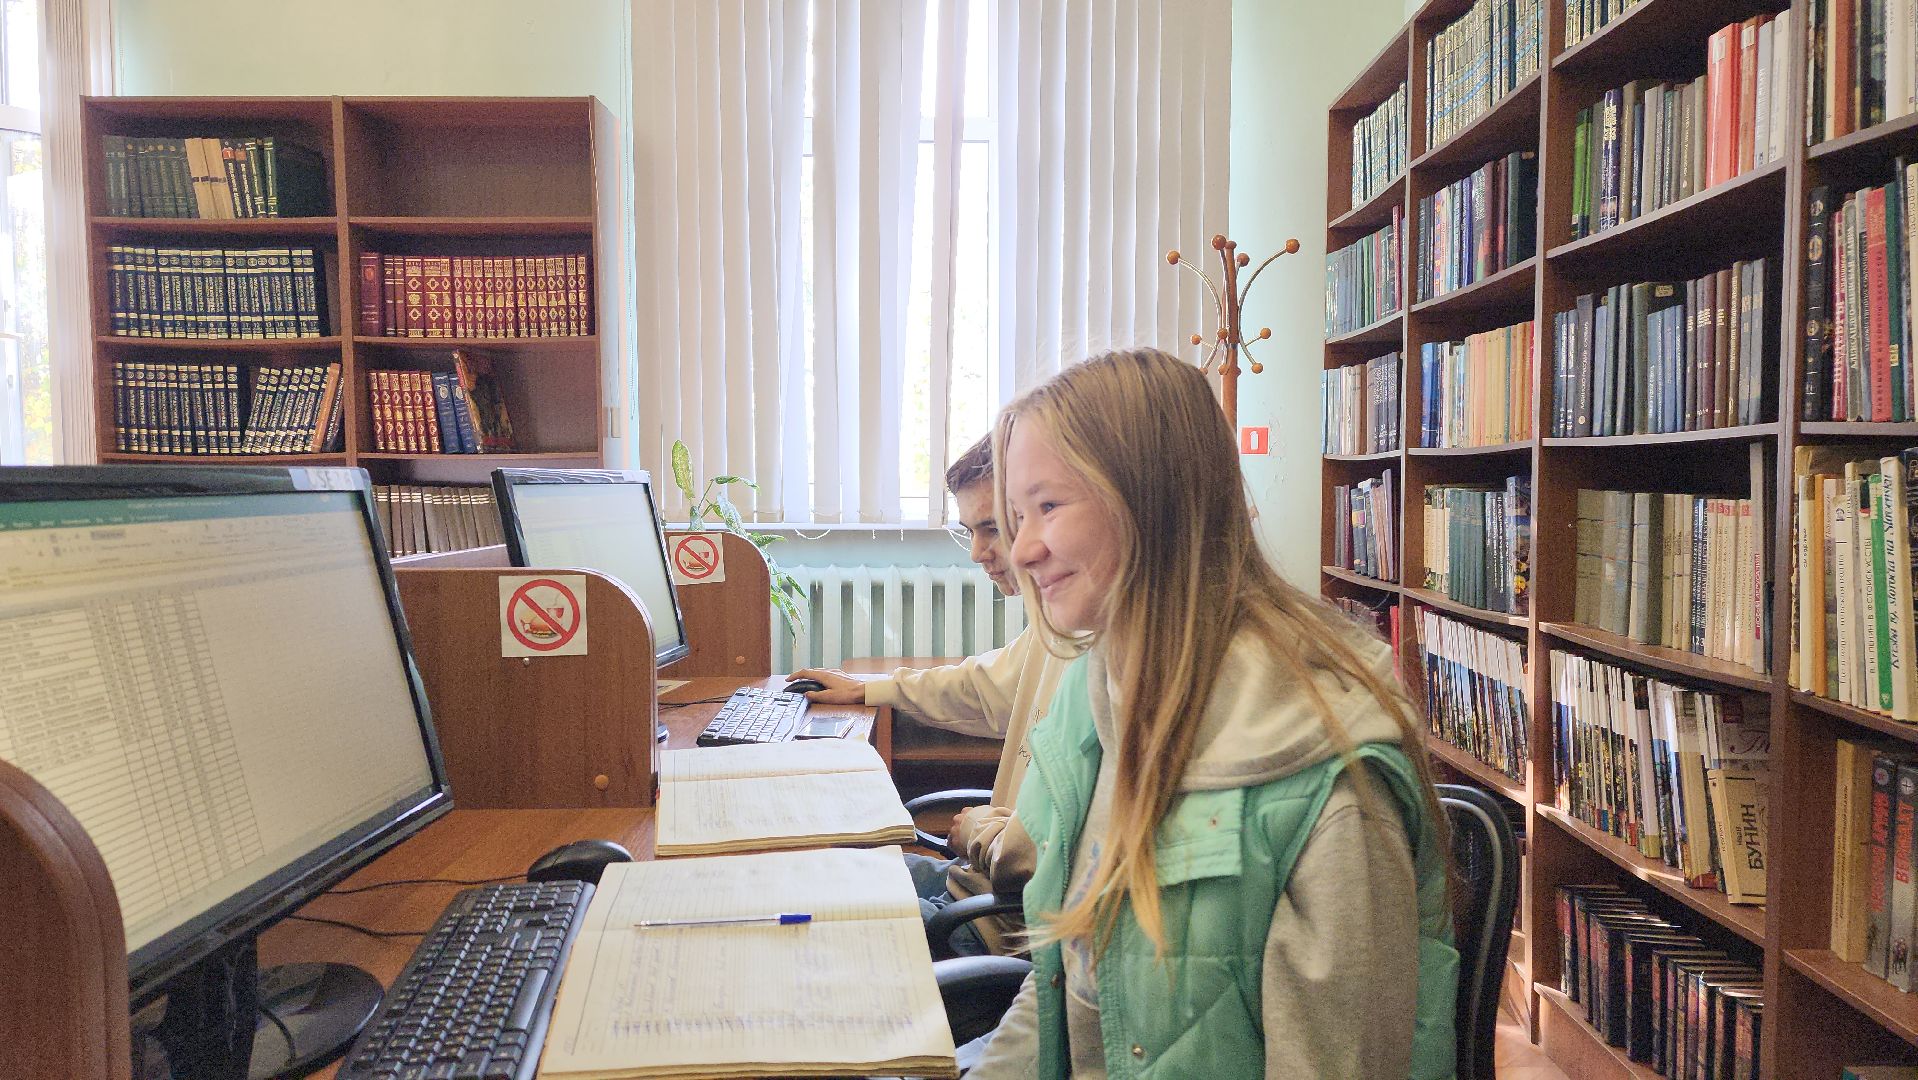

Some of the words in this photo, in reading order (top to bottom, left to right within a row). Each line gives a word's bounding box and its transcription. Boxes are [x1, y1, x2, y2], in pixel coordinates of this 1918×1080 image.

[1884, 539, 1894, 556] na
[1740, 804, 1764, 870] БУНИН
[1895, 800, 1914, 884] ВЕРМАХТ
